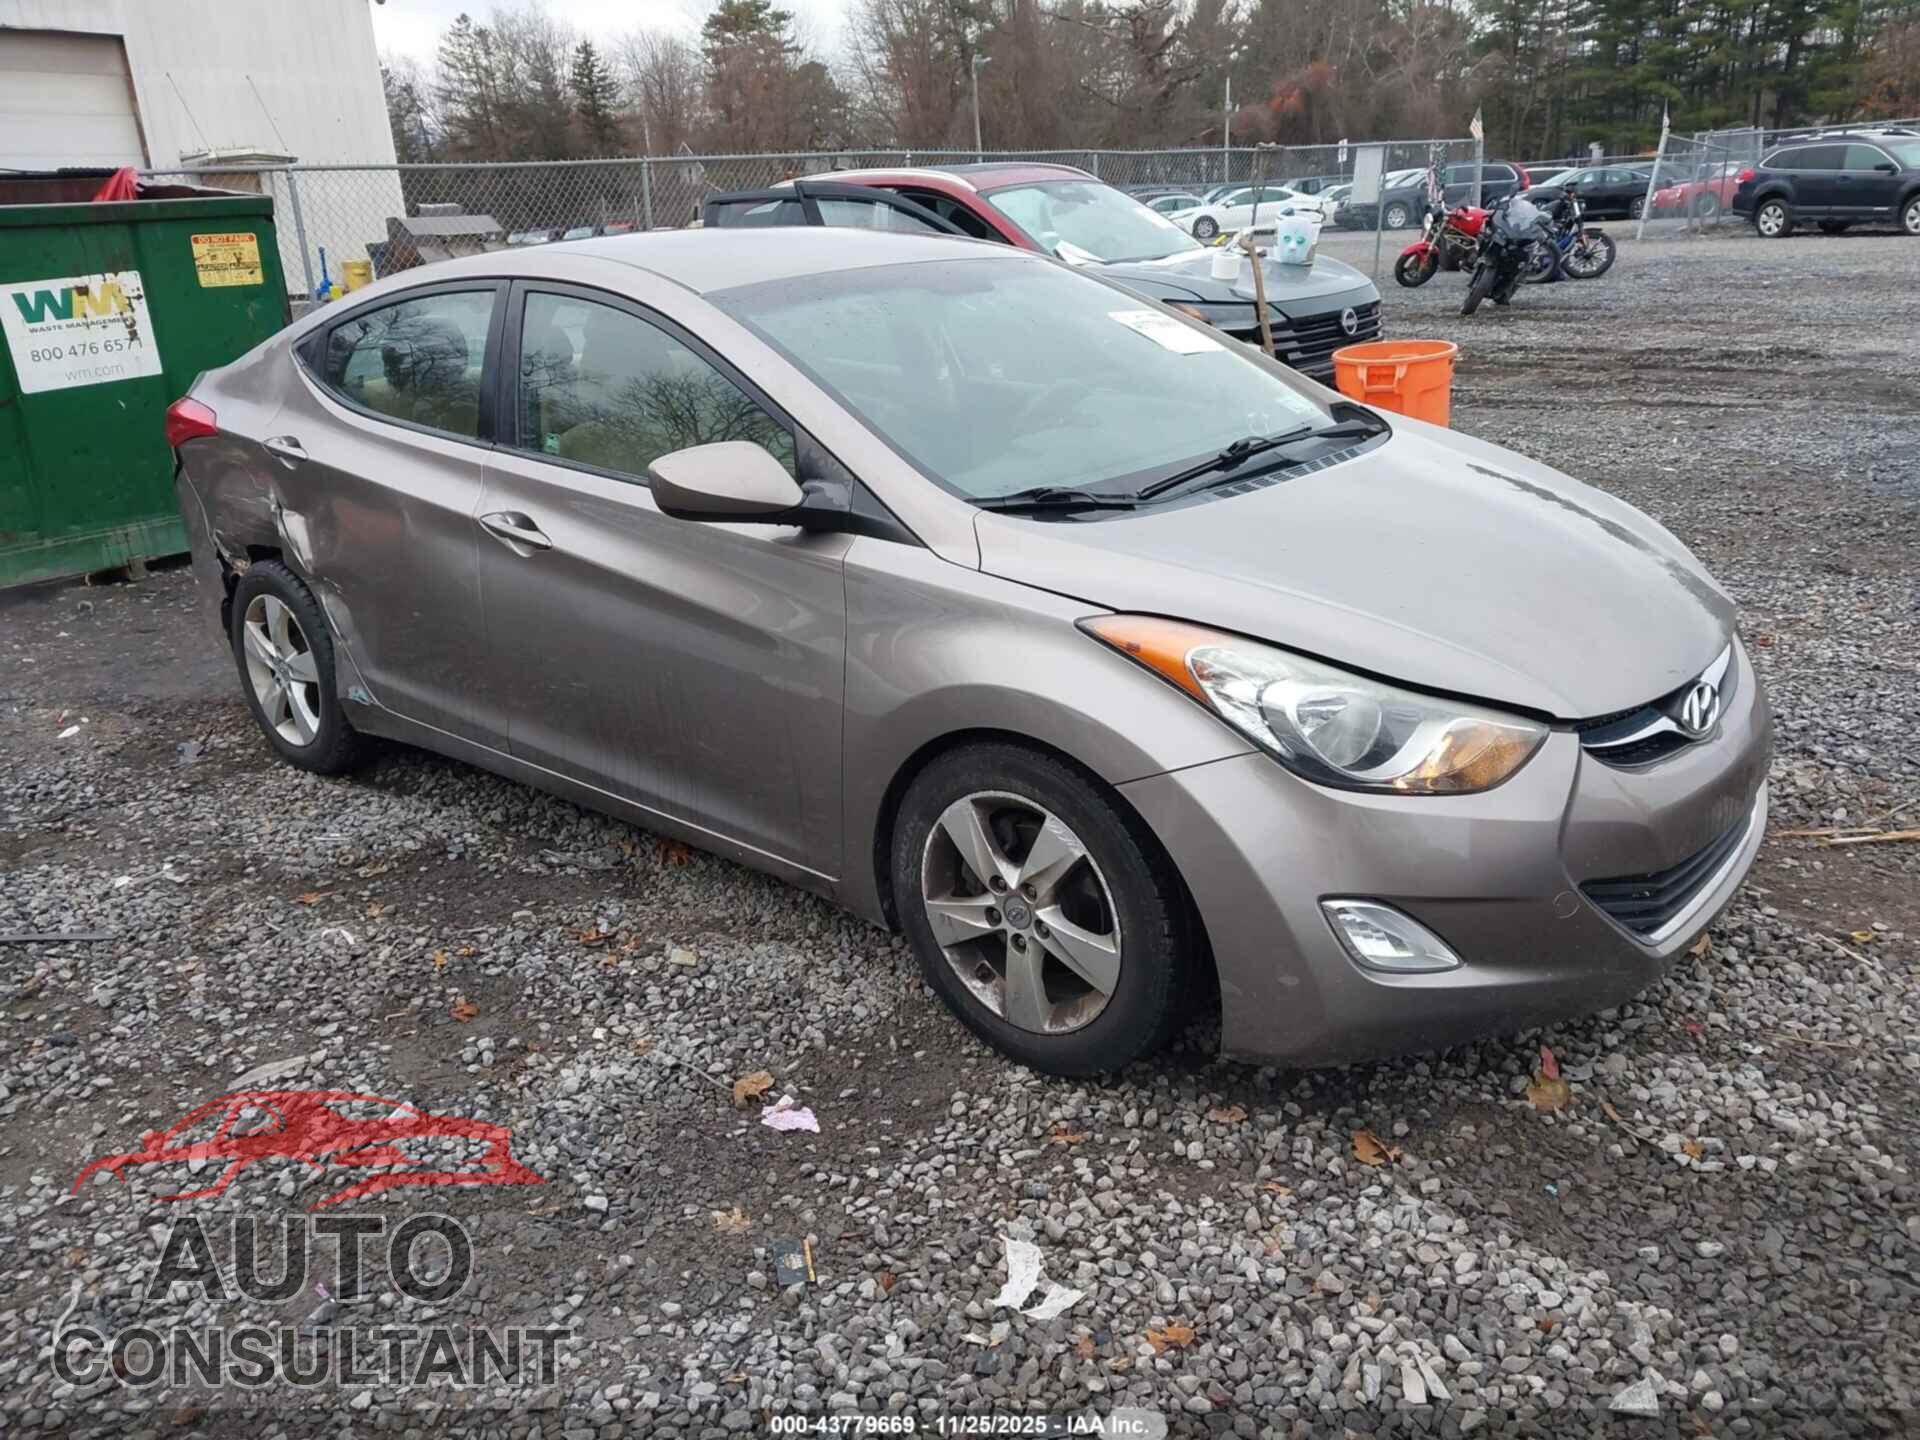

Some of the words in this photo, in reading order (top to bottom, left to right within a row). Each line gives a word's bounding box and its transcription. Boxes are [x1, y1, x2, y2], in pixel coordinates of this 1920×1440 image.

[11, 282, 129, 324] WM
[28, 324, 63, 334] WASTE
[31, 346, 63, 362] 800
[68, 341, 99, 357] 476
[65, 364, 124, 381] wm.com
